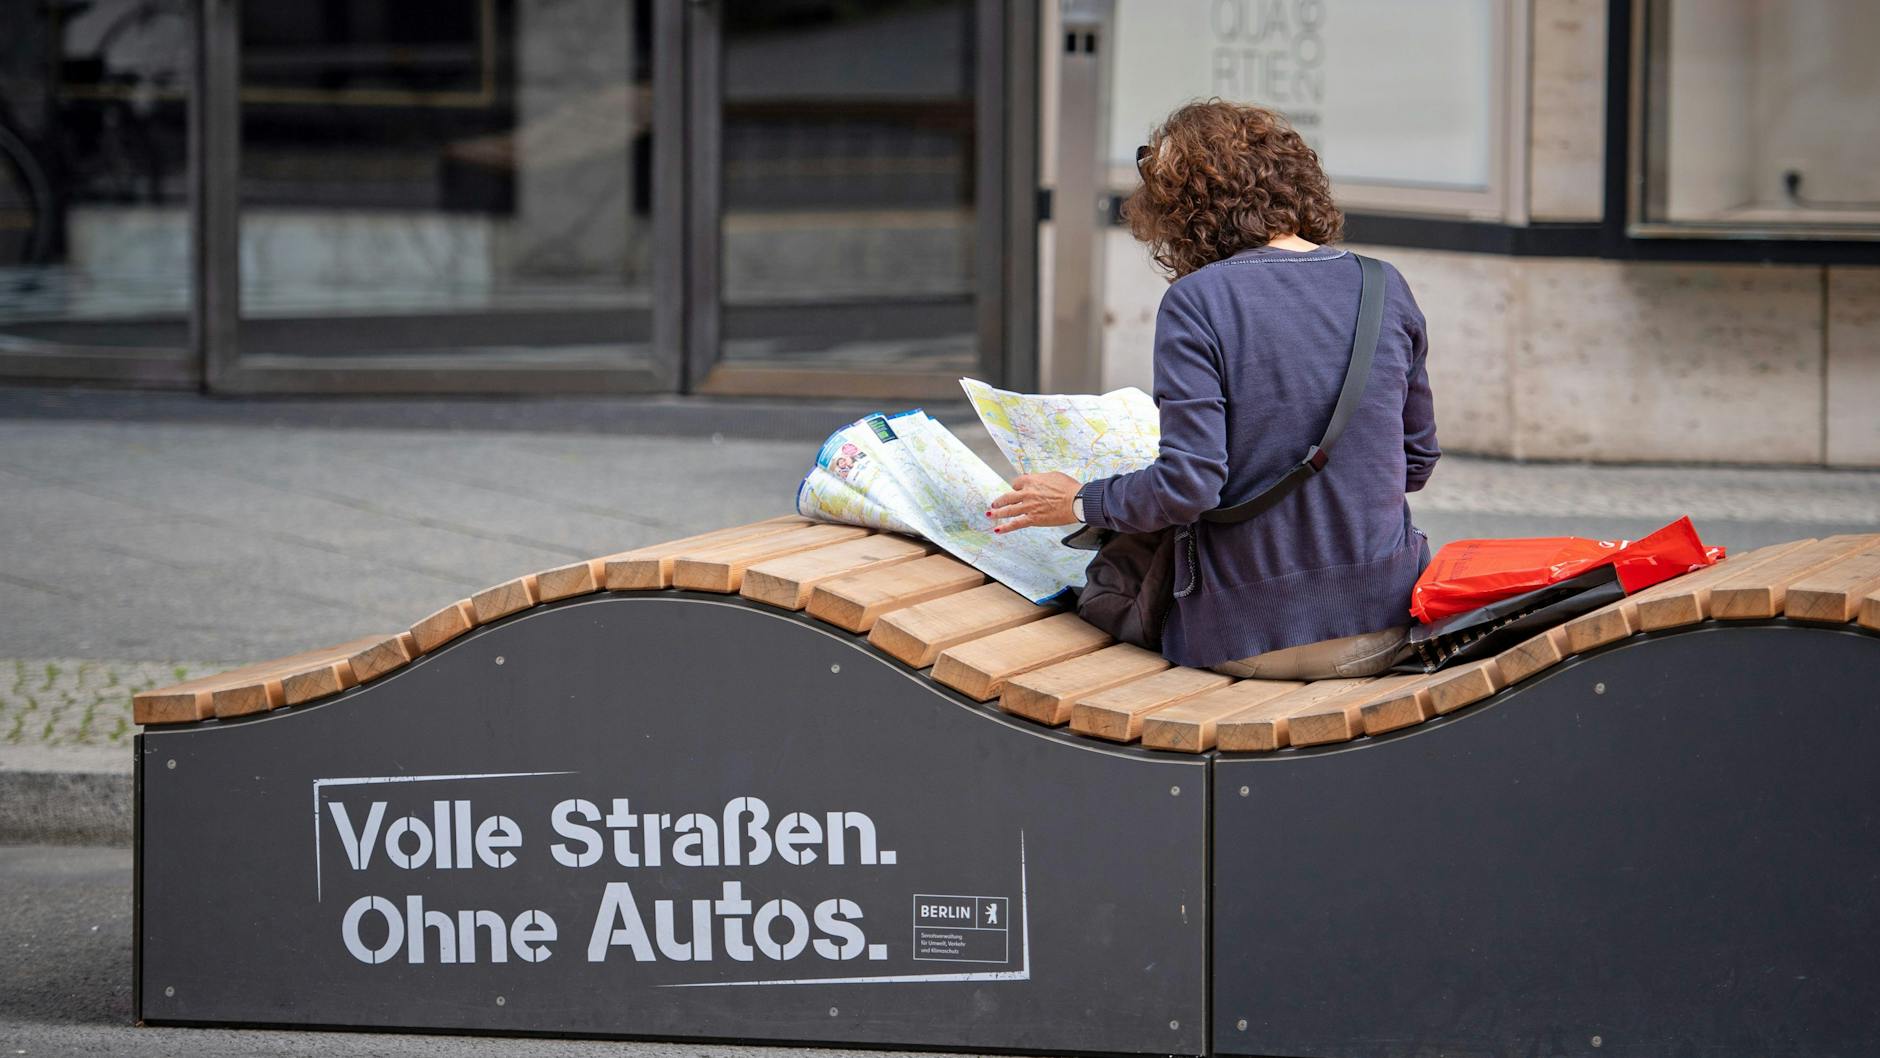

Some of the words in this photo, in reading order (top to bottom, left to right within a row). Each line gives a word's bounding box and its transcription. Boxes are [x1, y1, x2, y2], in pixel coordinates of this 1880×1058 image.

[328, 800, 522, 869] Volle
[551, 797, 896, 867] Straßen.
[342, 895, 557, 963] Ohne
[588, 881, 887, 961] Autos.
[921, 905, 970, 919] BERLIN
